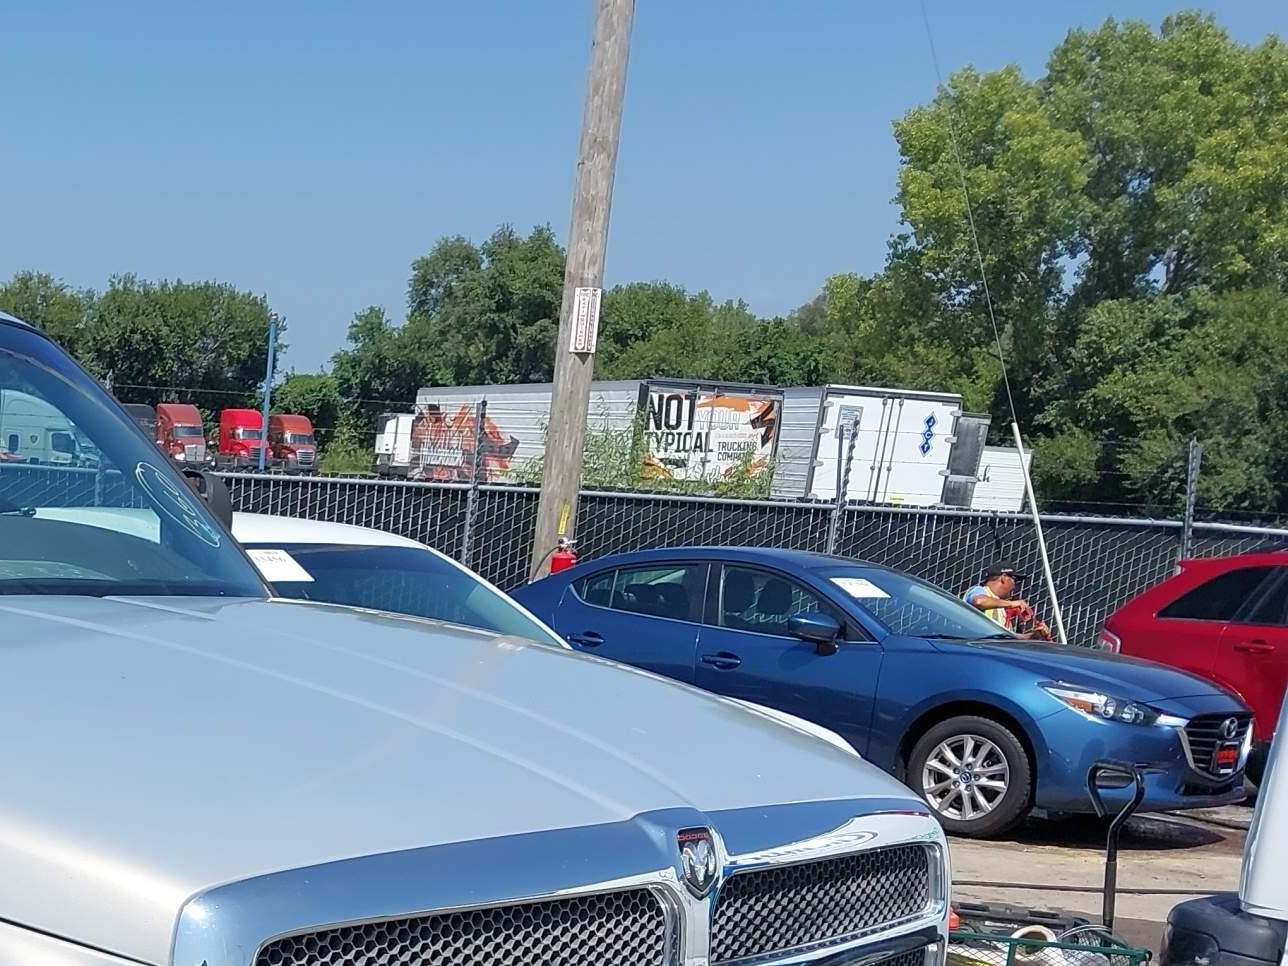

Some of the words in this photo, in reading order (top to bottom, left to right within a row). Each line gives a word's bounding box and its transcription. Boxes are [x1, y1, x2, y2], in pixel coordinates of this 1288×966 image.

[646, 393, 700, 431] NOT
[644, 432, 713, 453] TYPICAL
[717, 441, 758, 453] TRUCKING
